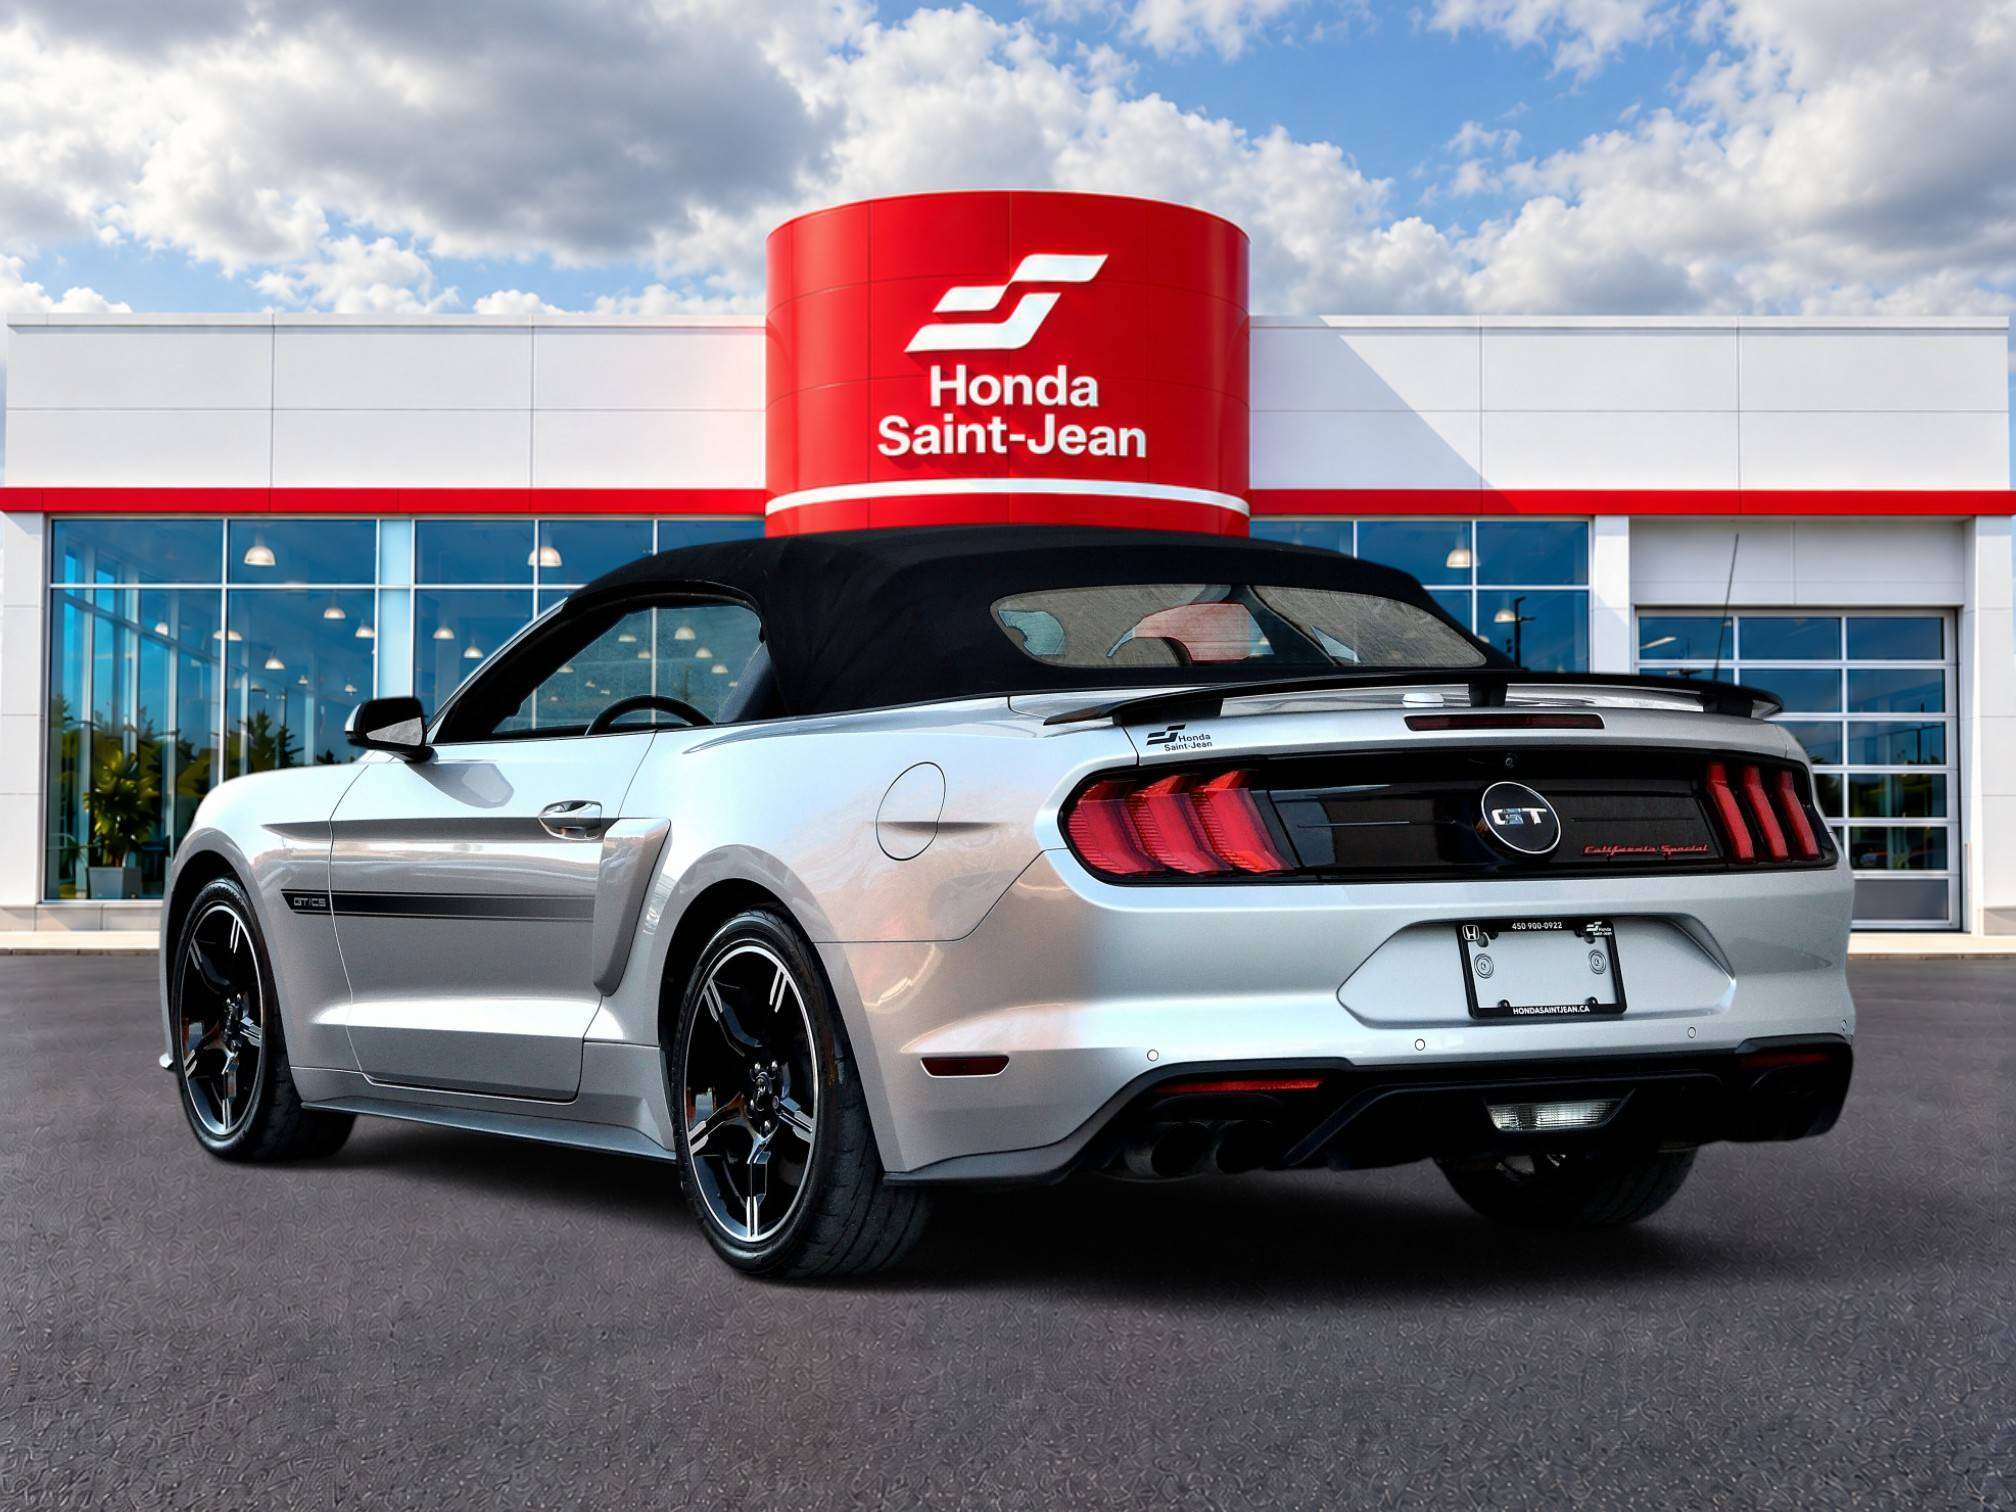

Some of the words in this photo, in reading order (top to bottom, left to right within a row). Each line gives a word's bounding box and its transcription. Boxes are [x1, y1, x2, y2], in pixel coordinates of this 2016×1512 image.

[930, 364, 1099, 407] Honda
[877, 413, 1147, 458] Saint-Jean
[1178, 733, 1211, 743] Honda
[1163, 740, 1213, 752] Saint-Jean
[1491, 808, 1548, 825] GT
[1583, 844, 1657, 857] California
[1660, 842, 1709, 856] Special
[1511, 922, 1526, 930] 450
[1527, 921, 1563, 930] 900-0922
[1512, 1005, 1591, 1015] HONDASAINTJEAN.CA
